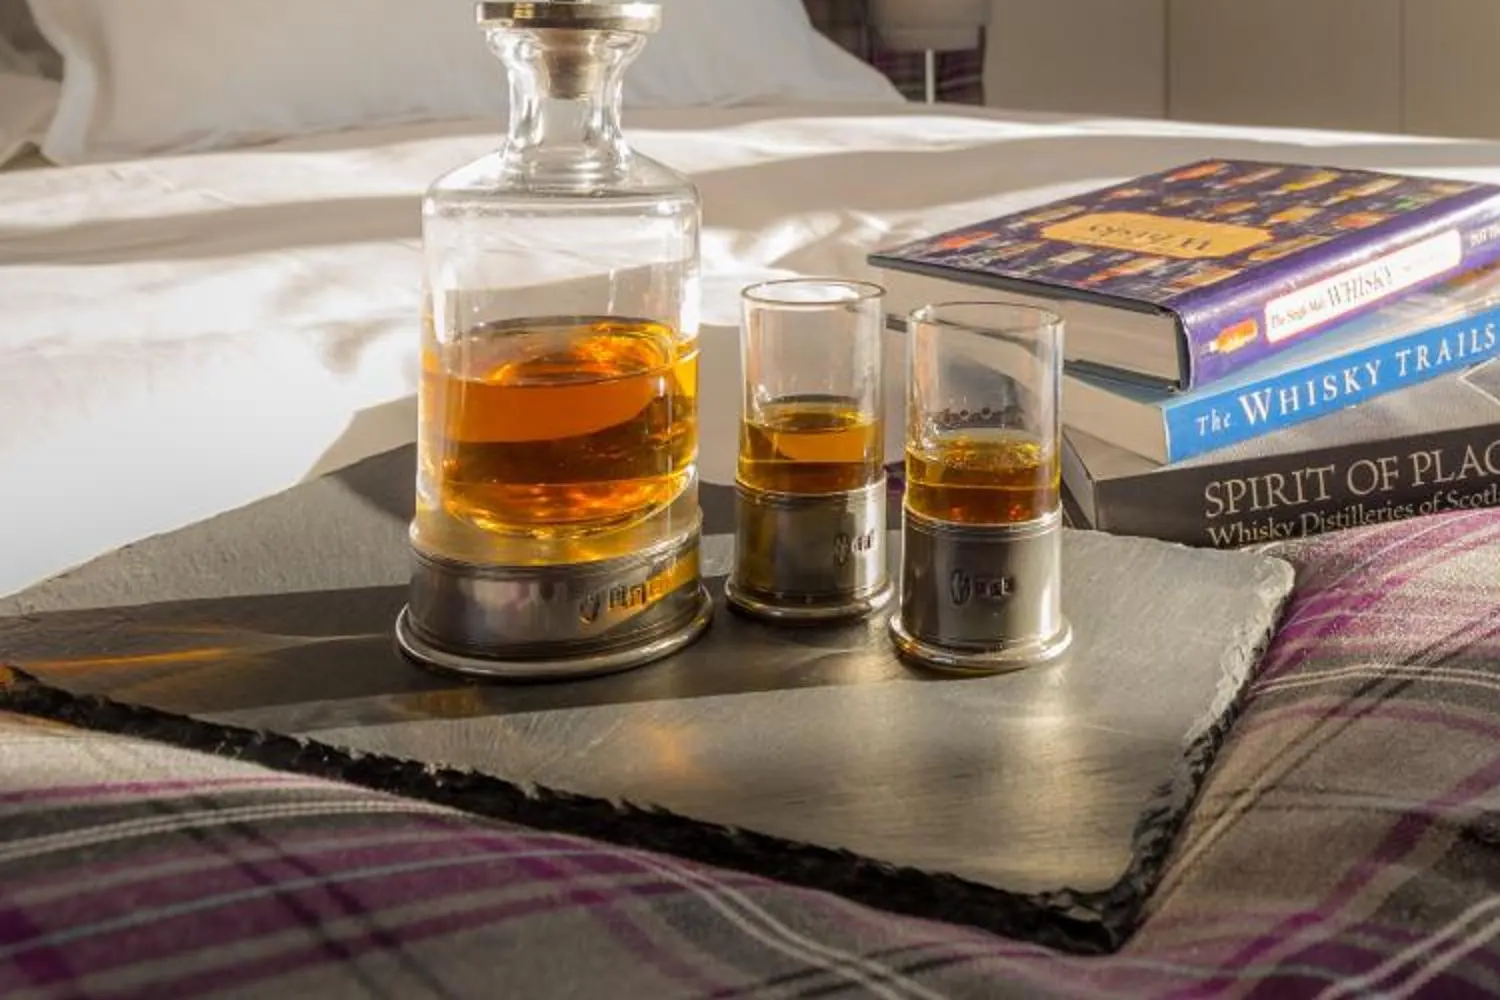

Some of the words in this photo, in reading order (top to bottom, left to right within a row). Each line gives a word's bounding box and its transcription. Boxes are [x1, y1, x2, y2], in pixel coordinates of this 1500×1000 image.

[1196, 408, 1231, 436] The
[1239, 359, 1383, 425] WHISKY
[1396, 323, 1496, 376] TRAILS
[1204, 464, 1335, 518] SPIRIT
[1347, 455, 1399, 495] OF
[1206, 517, 1294, 546] Whisky
[1302, 499, 1414, 538] Distilleries
[1420, 491, 1443, 513] of
